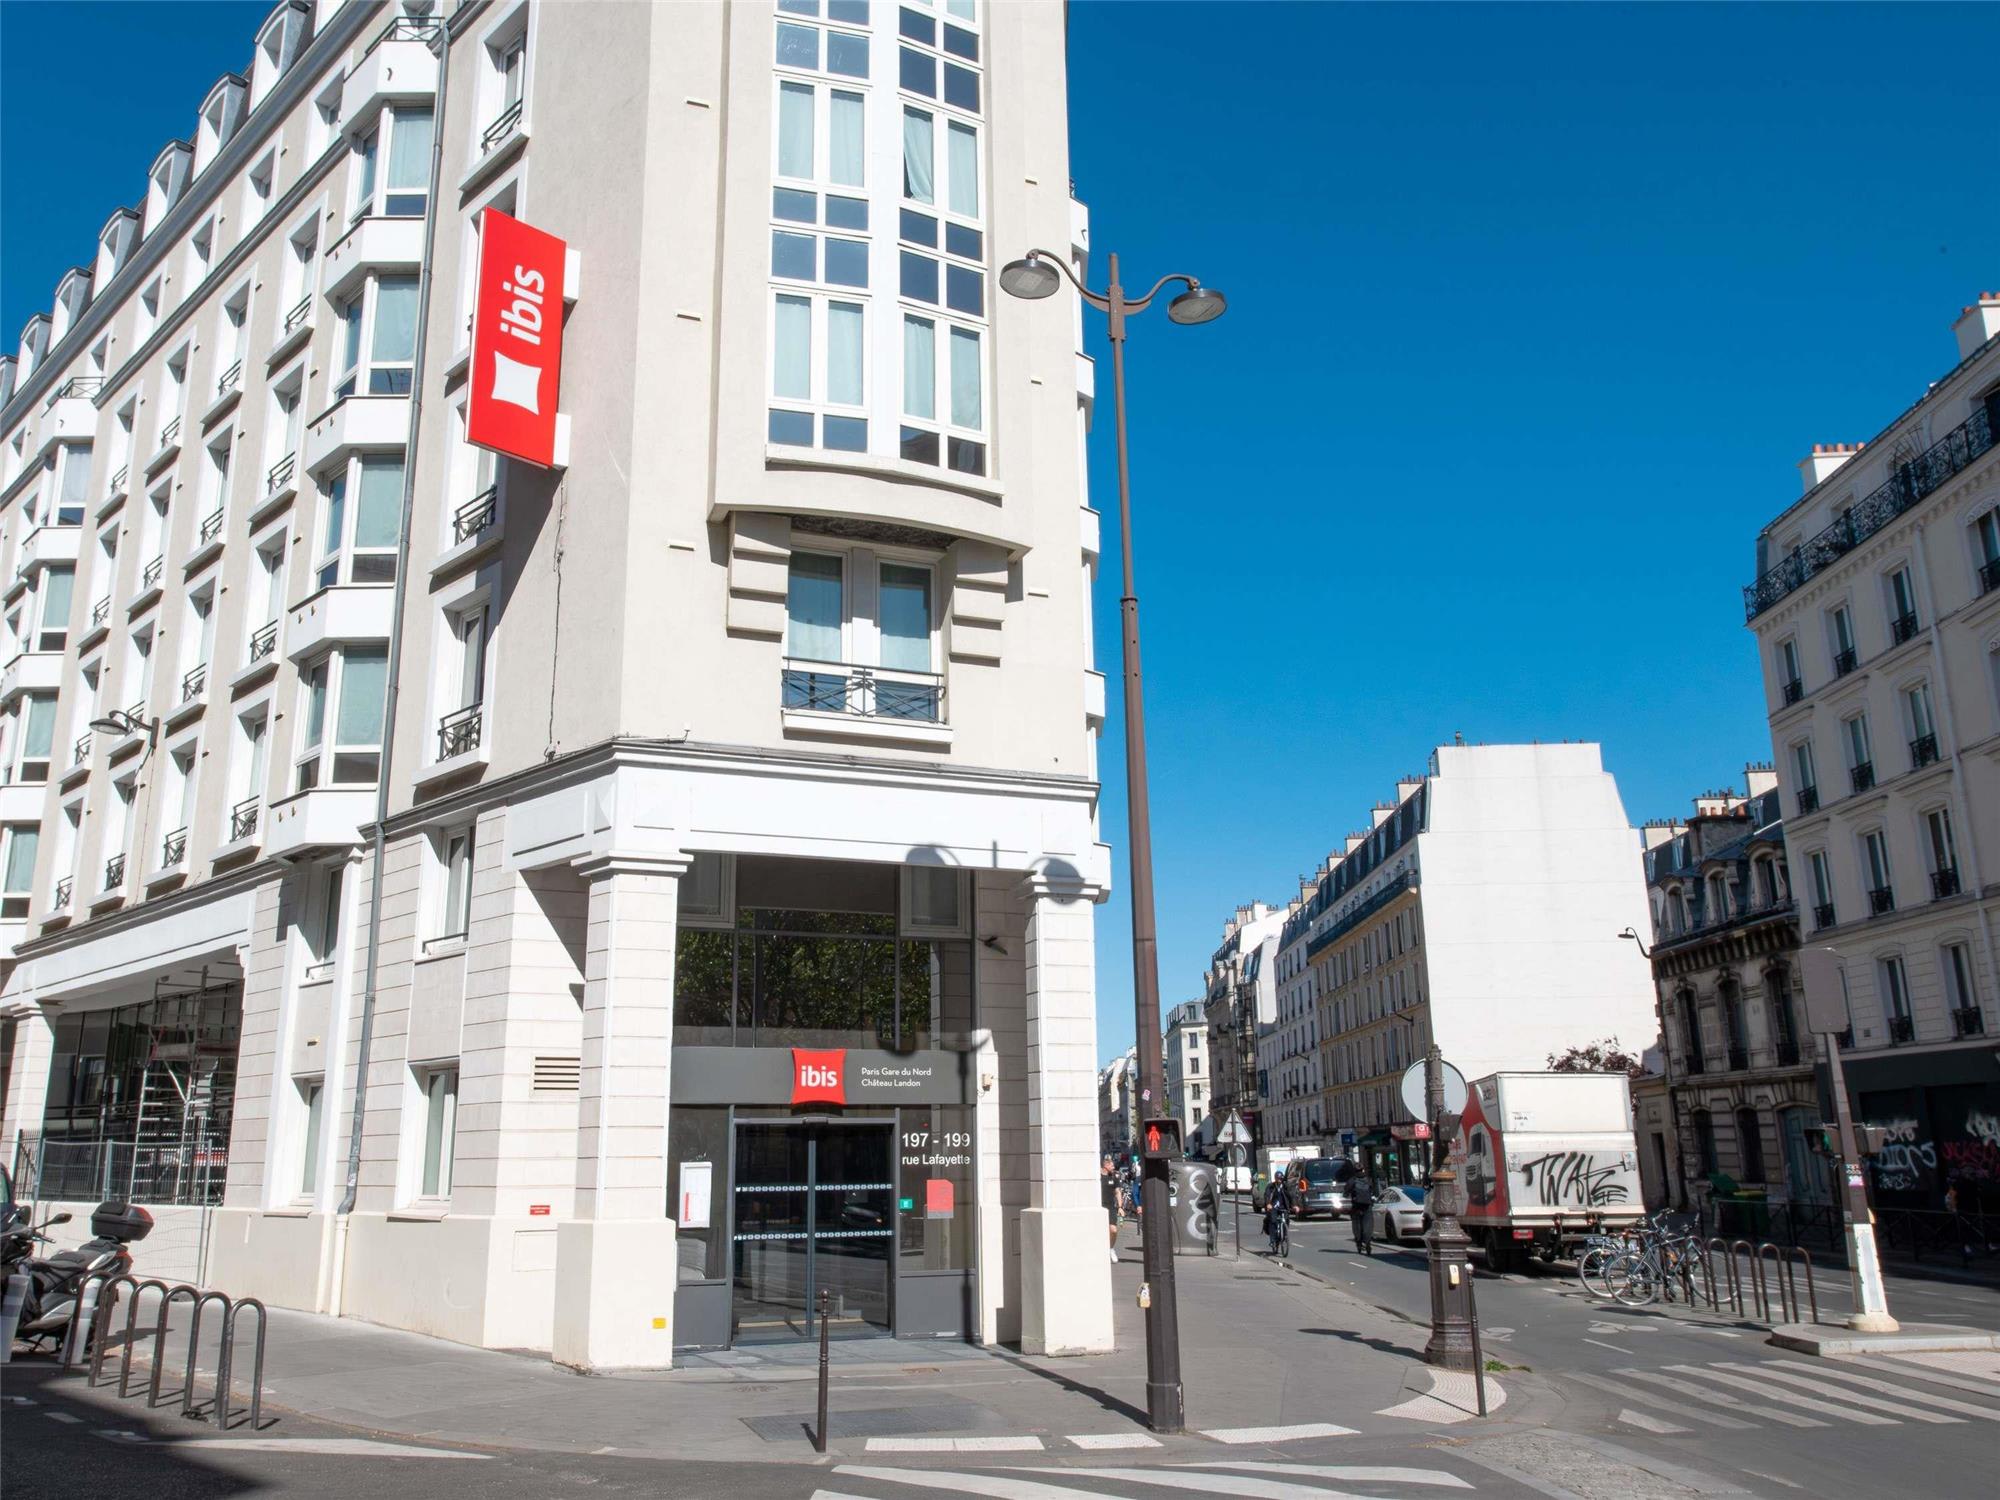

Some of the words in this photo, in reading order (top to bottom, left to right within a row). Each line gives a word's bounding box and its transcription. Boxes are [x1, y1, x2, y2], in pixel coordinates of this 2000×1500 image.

[500, 264, 545, 346] ibis
[801, 1065, 838, 1088] ibis
[861, 1067, 880, 1076] Paris
[881, 1067, 900, 1076] Gare
[901, 1067, 911, 1076] du
[912, 1067, 932, 1076] Nord
[861, 1077, 893, 1087] Château
[894, 1078, 921, 1087] Landon
[902, 1132, 929, 1148] 197
[944, 1132, 971, 1148] 199
[902, 1156, 920, 1165] rue
[922, 1154, 971, 1168] Lafayette
